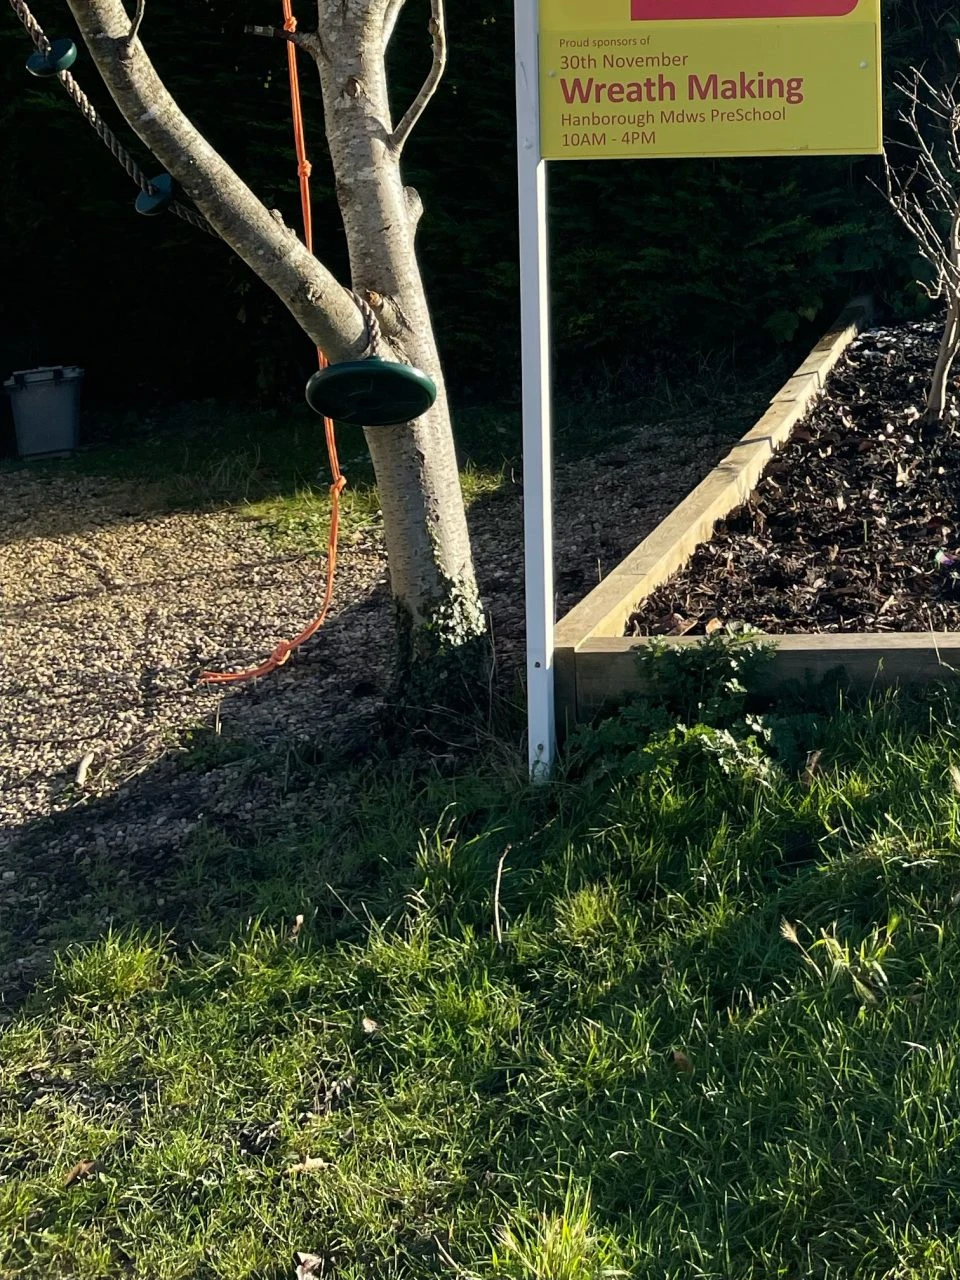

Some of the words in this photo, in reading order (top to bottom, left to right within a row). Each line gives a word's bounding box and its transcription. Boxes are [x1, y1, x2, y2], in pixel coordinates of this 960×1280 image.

[559, 37, 590, 49] Proud
[592, 36, 638, 49] sponsors
[640, 36, 652, 46] of
[560, 53, 598, 70] 30th
[603, 52, 689, 69] November
[560, 74, 677, 105] Wreath
[688, 71, 804, 105] Making
[561, 111, 656, 128] Hanborough
[660, 109, 706, 125] Mdws
[711, 107, 786, 122] PreSchool
[562, 132, 607, 147] 10AM
[621, 130, 657, 146] 4PM
